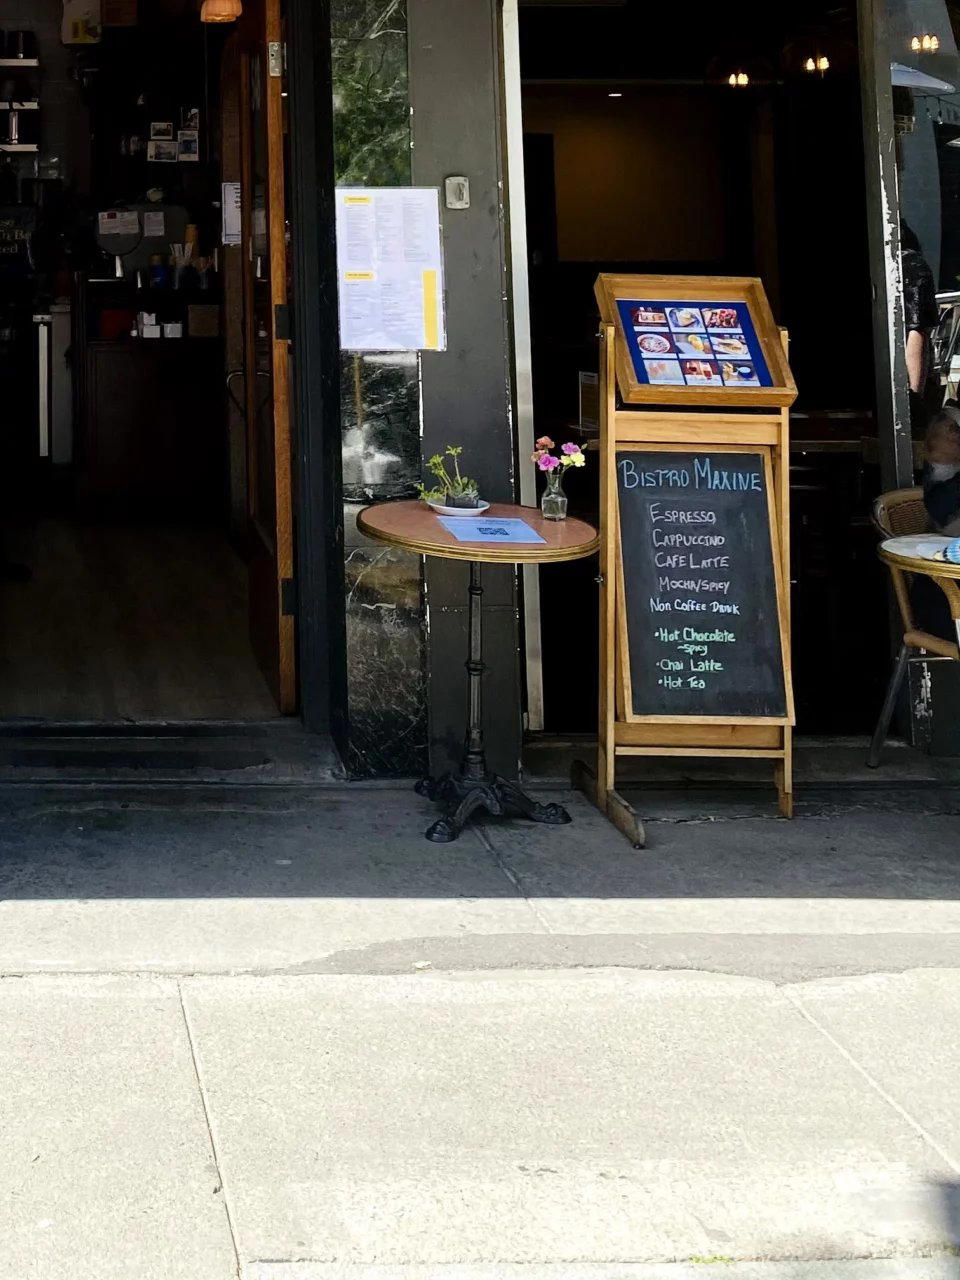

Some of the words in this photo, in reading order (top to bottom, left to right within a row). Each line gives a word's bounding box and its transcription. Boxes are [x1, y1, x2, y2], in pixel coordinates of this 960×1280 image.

[683, 627, 736, 641] Chocolate
[690, 659, 724, 671] Latte
[687, 676, 706, 688] Tea
